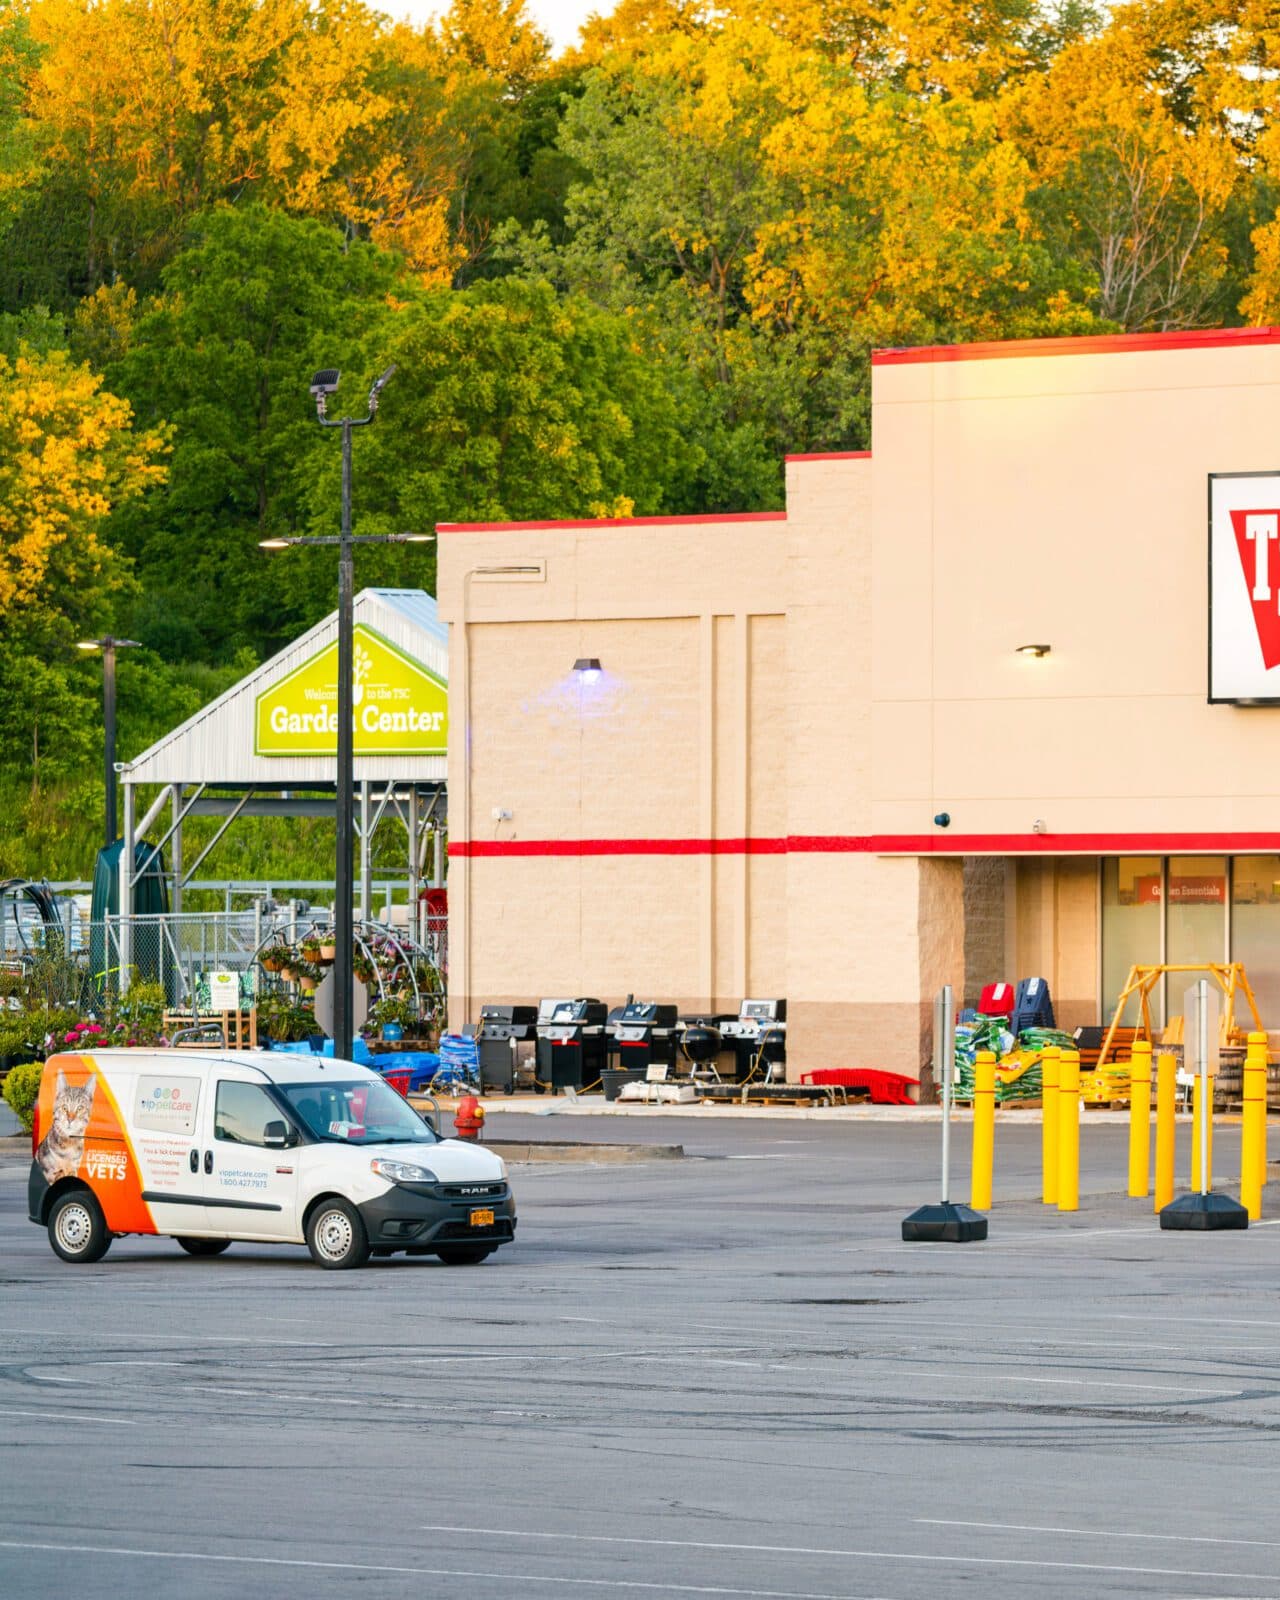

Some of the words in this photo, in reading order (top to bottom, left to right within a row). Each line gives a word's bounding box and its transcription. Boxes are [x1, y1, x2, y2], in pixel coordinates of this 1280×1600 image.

[304, 688, 338, 701] Welcom
[366, 688, 376, 700] to
[377, 688, 391, 700] the
[361, 704, 444, 732] Center
[1182, 885, 1220, 897] Essentials
[86, 1152, 128, 1164] LICENSED
[86, 1163, 127, 1181] VETS
[218, 1168, 268, 1179] vippetcare.com
